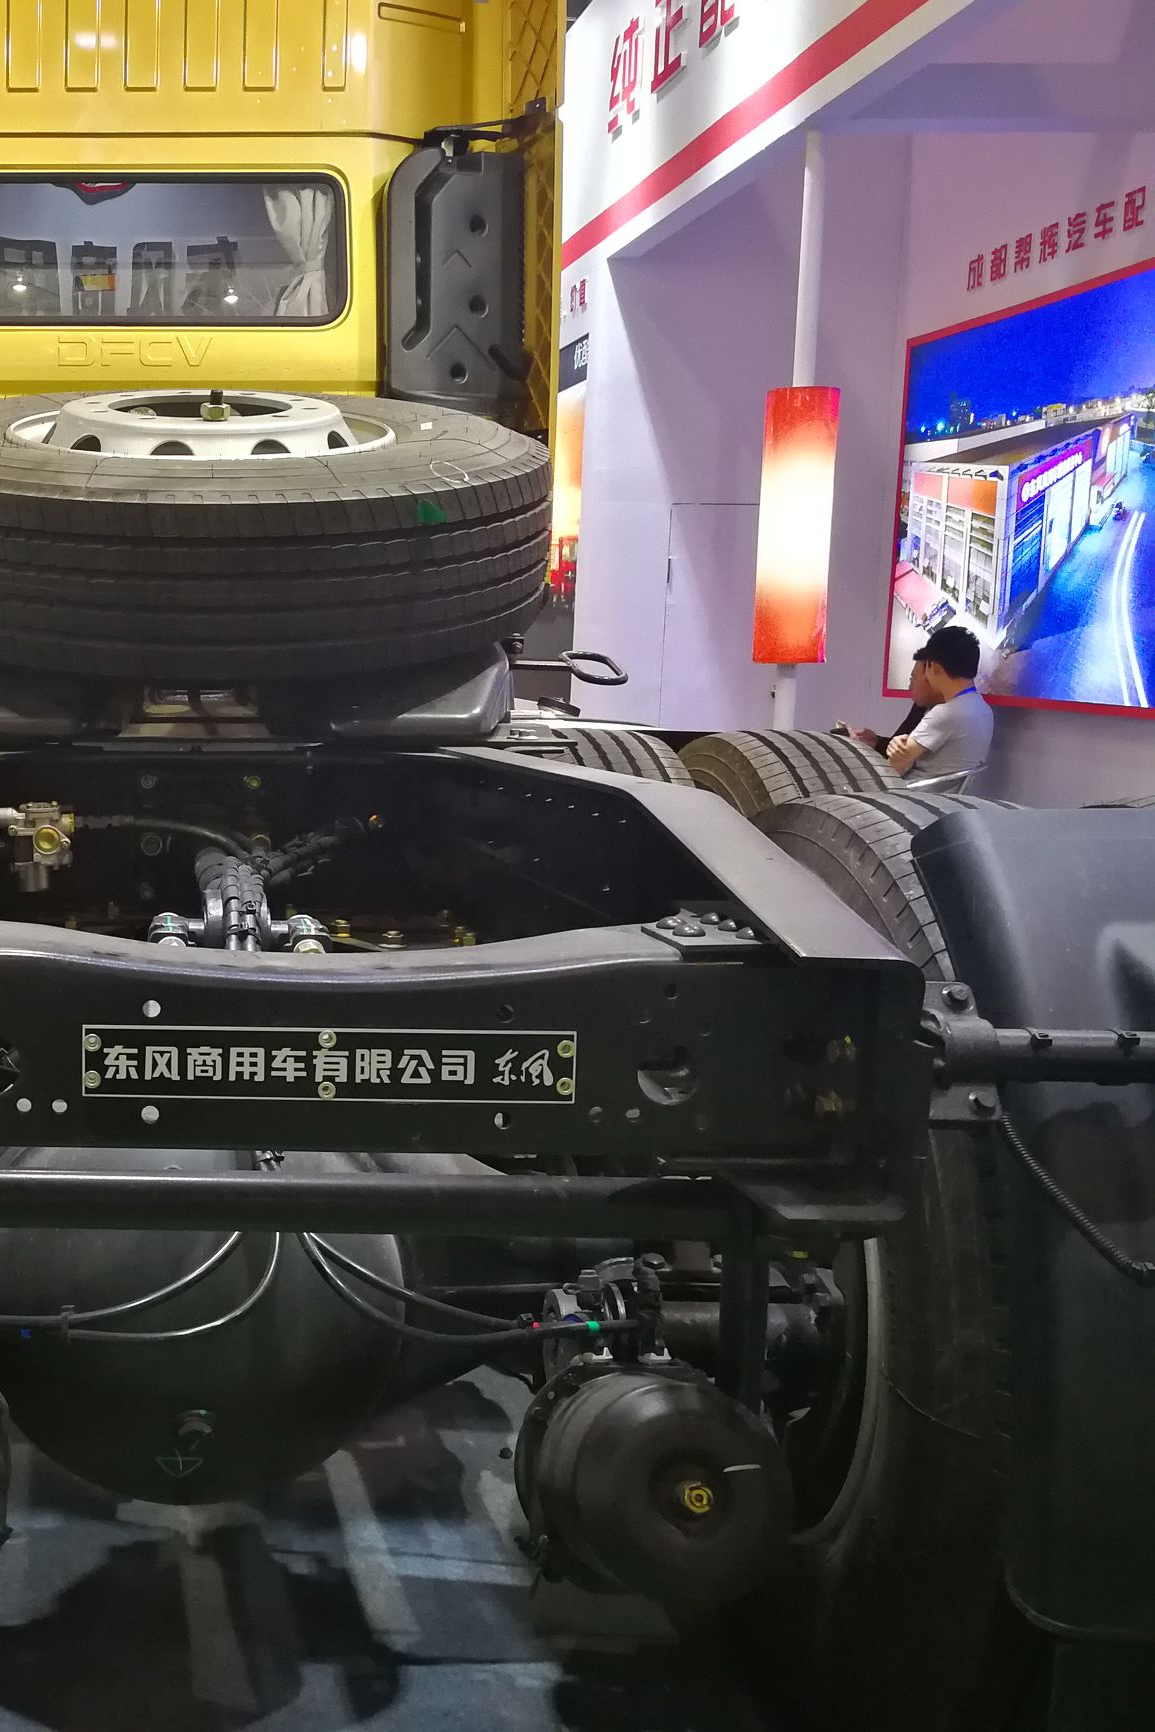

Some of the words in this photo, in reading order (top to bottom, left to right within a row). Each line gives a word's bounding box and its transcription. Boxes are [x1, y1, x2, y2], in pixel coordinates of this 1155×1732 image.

[967, 183, 1146, 291] 成都帮辉汽车配
[58, 335, 213, 367] DFCV
[103, 1045, 476, 1084] 东风商用车有限公司
